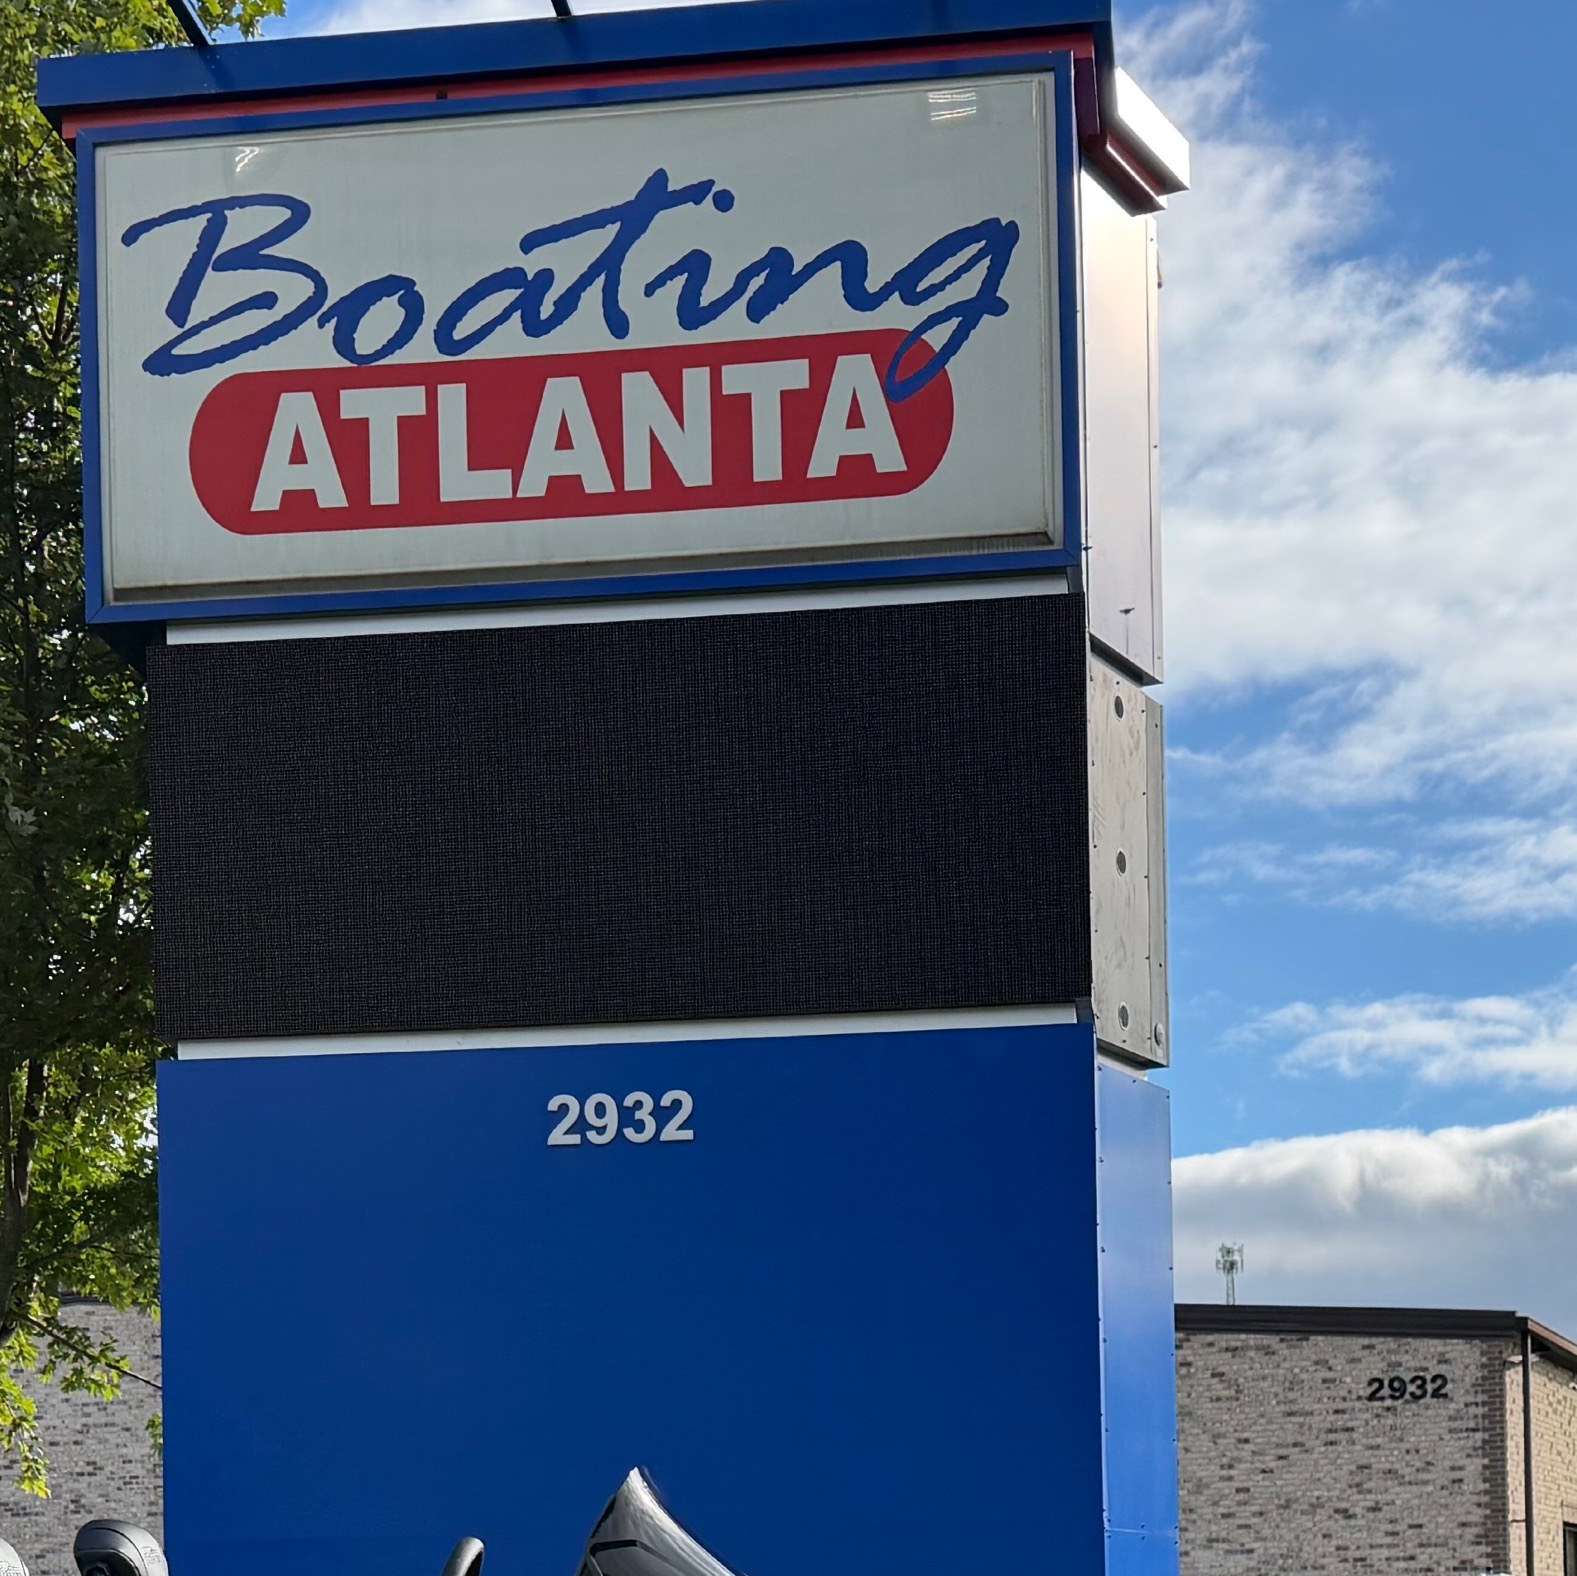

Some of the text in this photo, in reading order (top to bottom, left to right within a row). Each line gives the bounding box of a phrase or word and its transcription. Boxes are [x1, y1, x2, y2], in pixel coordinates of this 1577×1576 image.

[120, 167, 1020, 404] Boating
[249, 352, 908, 514] ATLANTA
[546, 1089, 694, 1146] 2932
[1366, 1373, 1449, 1401] 2932
